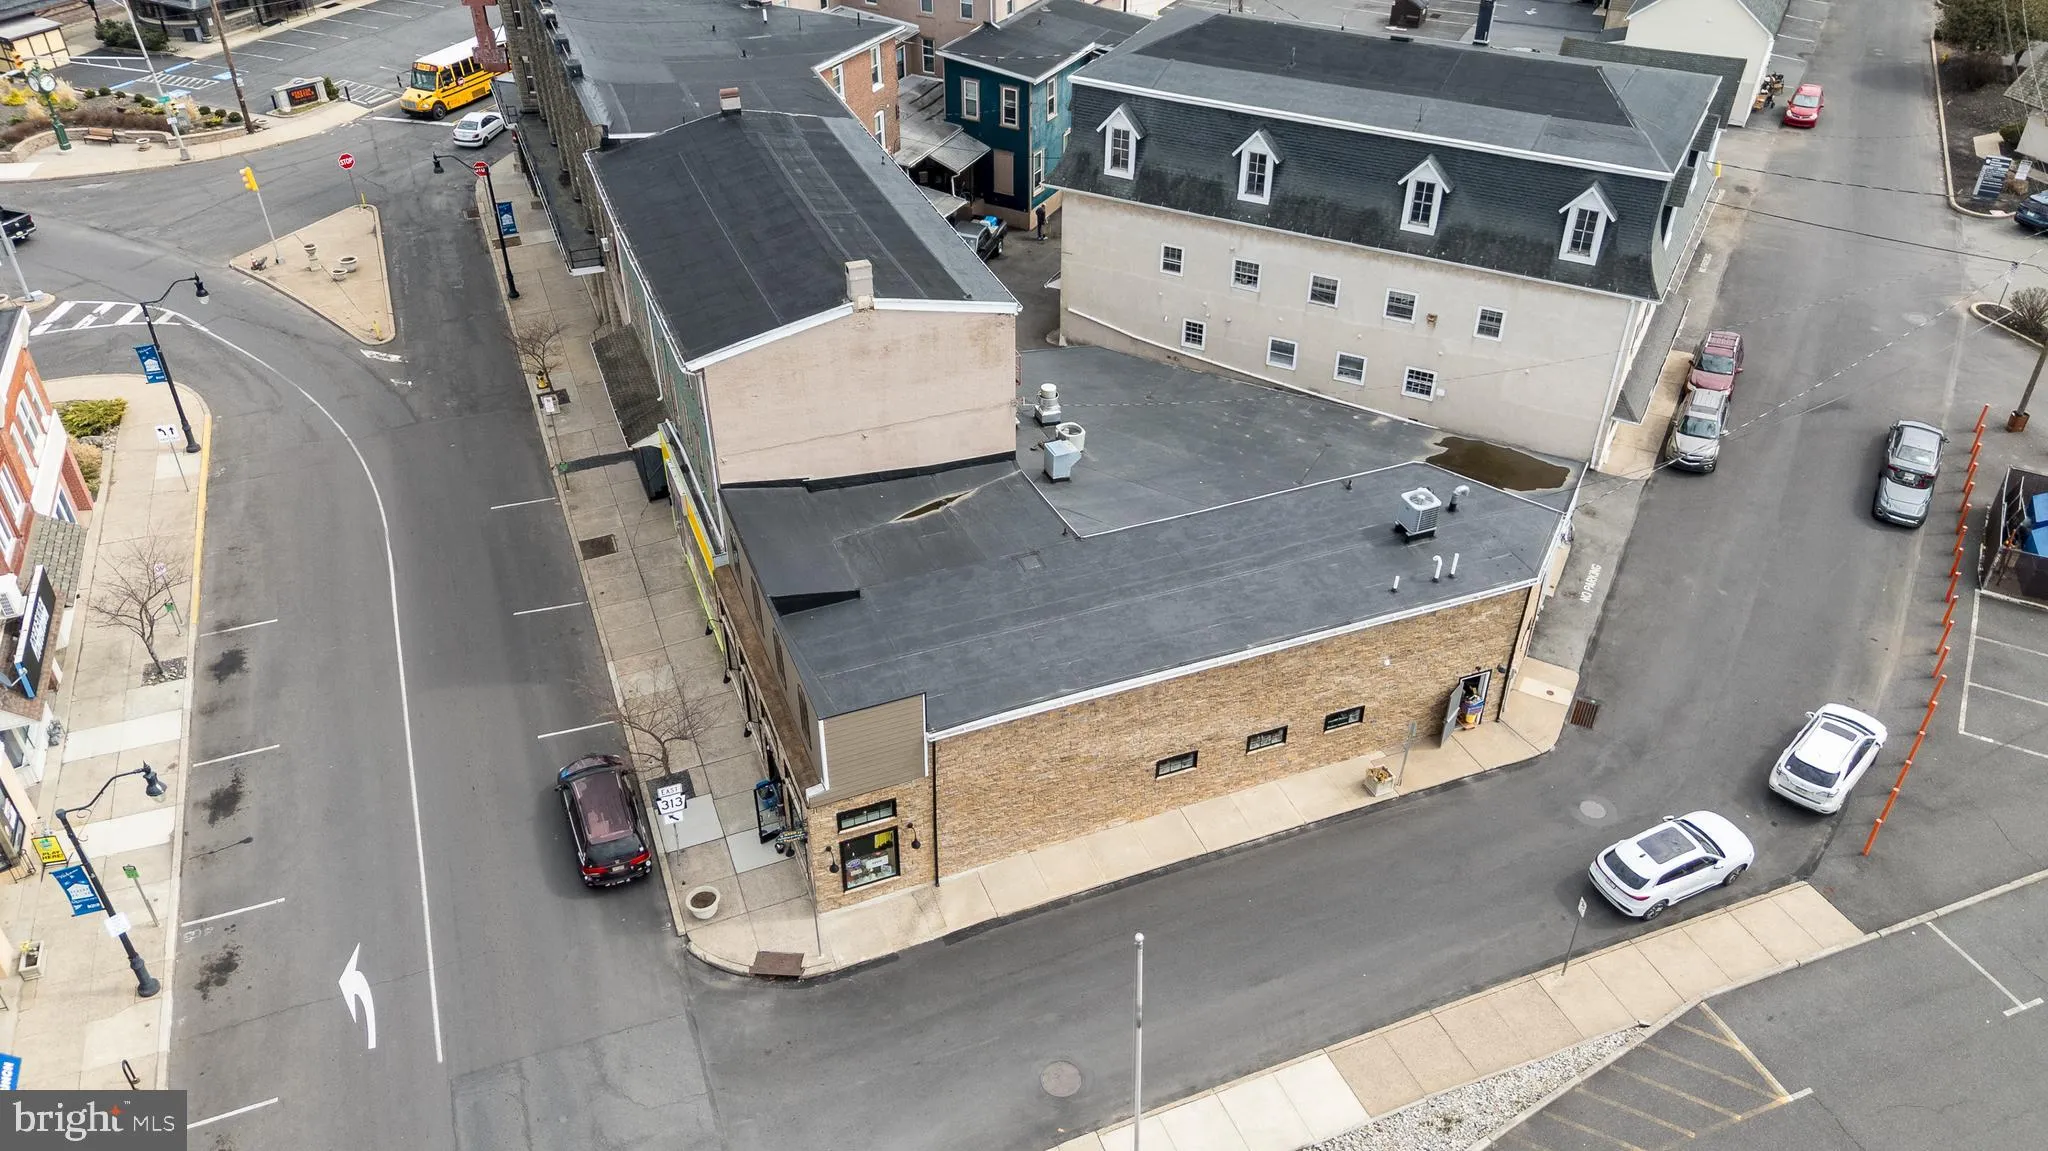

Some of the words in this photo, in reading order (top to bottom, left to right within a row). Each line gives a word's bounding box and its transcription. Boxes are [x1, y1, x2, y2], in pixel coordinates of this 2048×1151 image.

[339, 157, 353, 166] STOP
[1583, 563, 1602, 592] PARKING
[1580, 591, 1593, 603] NO
[661, 786, 678, 796] EAST
[661, 796, 683, 810] 313
